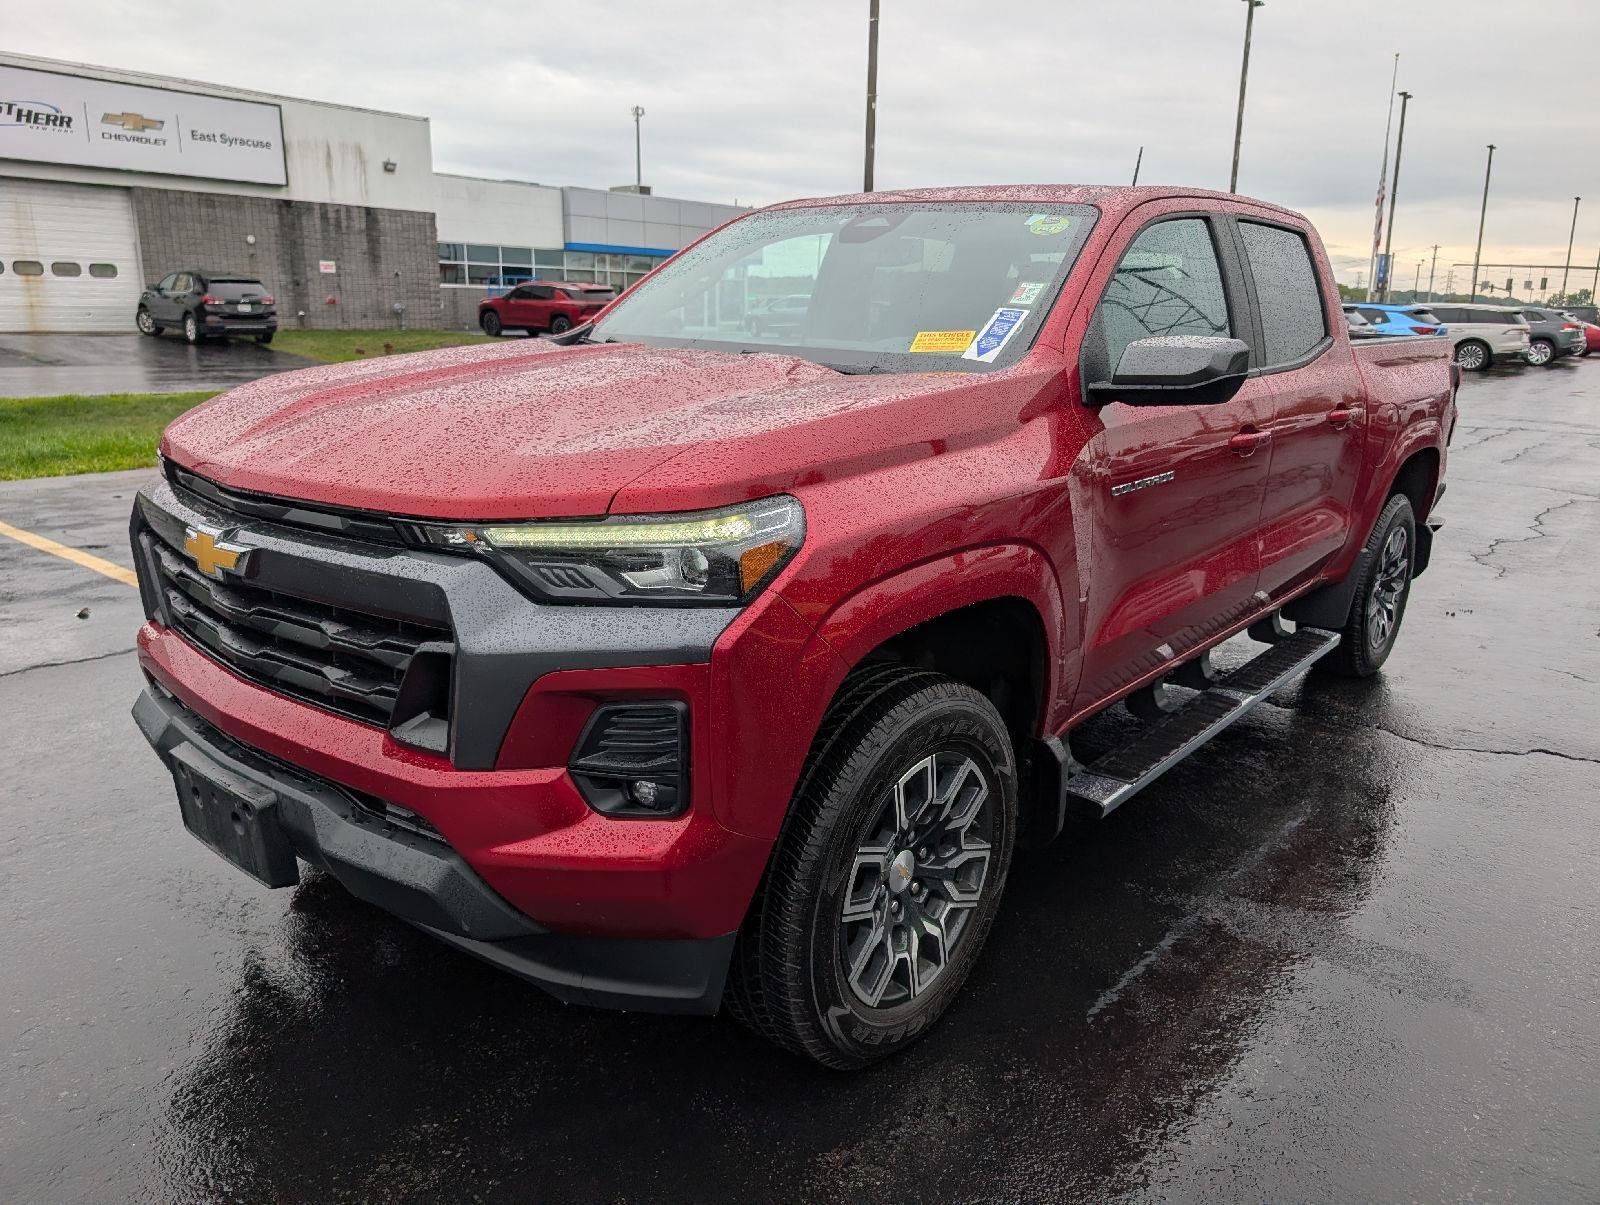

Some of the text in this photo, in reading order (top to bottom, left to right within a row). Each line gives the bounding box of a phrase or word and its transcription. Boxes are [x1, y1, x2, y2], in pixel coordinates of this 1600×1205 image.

[16, 108, 73, 129] HERR
[101, 131, 168, 146] CHEVROLET
[191, 130, 272, 150] East Syracuse
[1112, 472, 1174, 496] COLORADO
